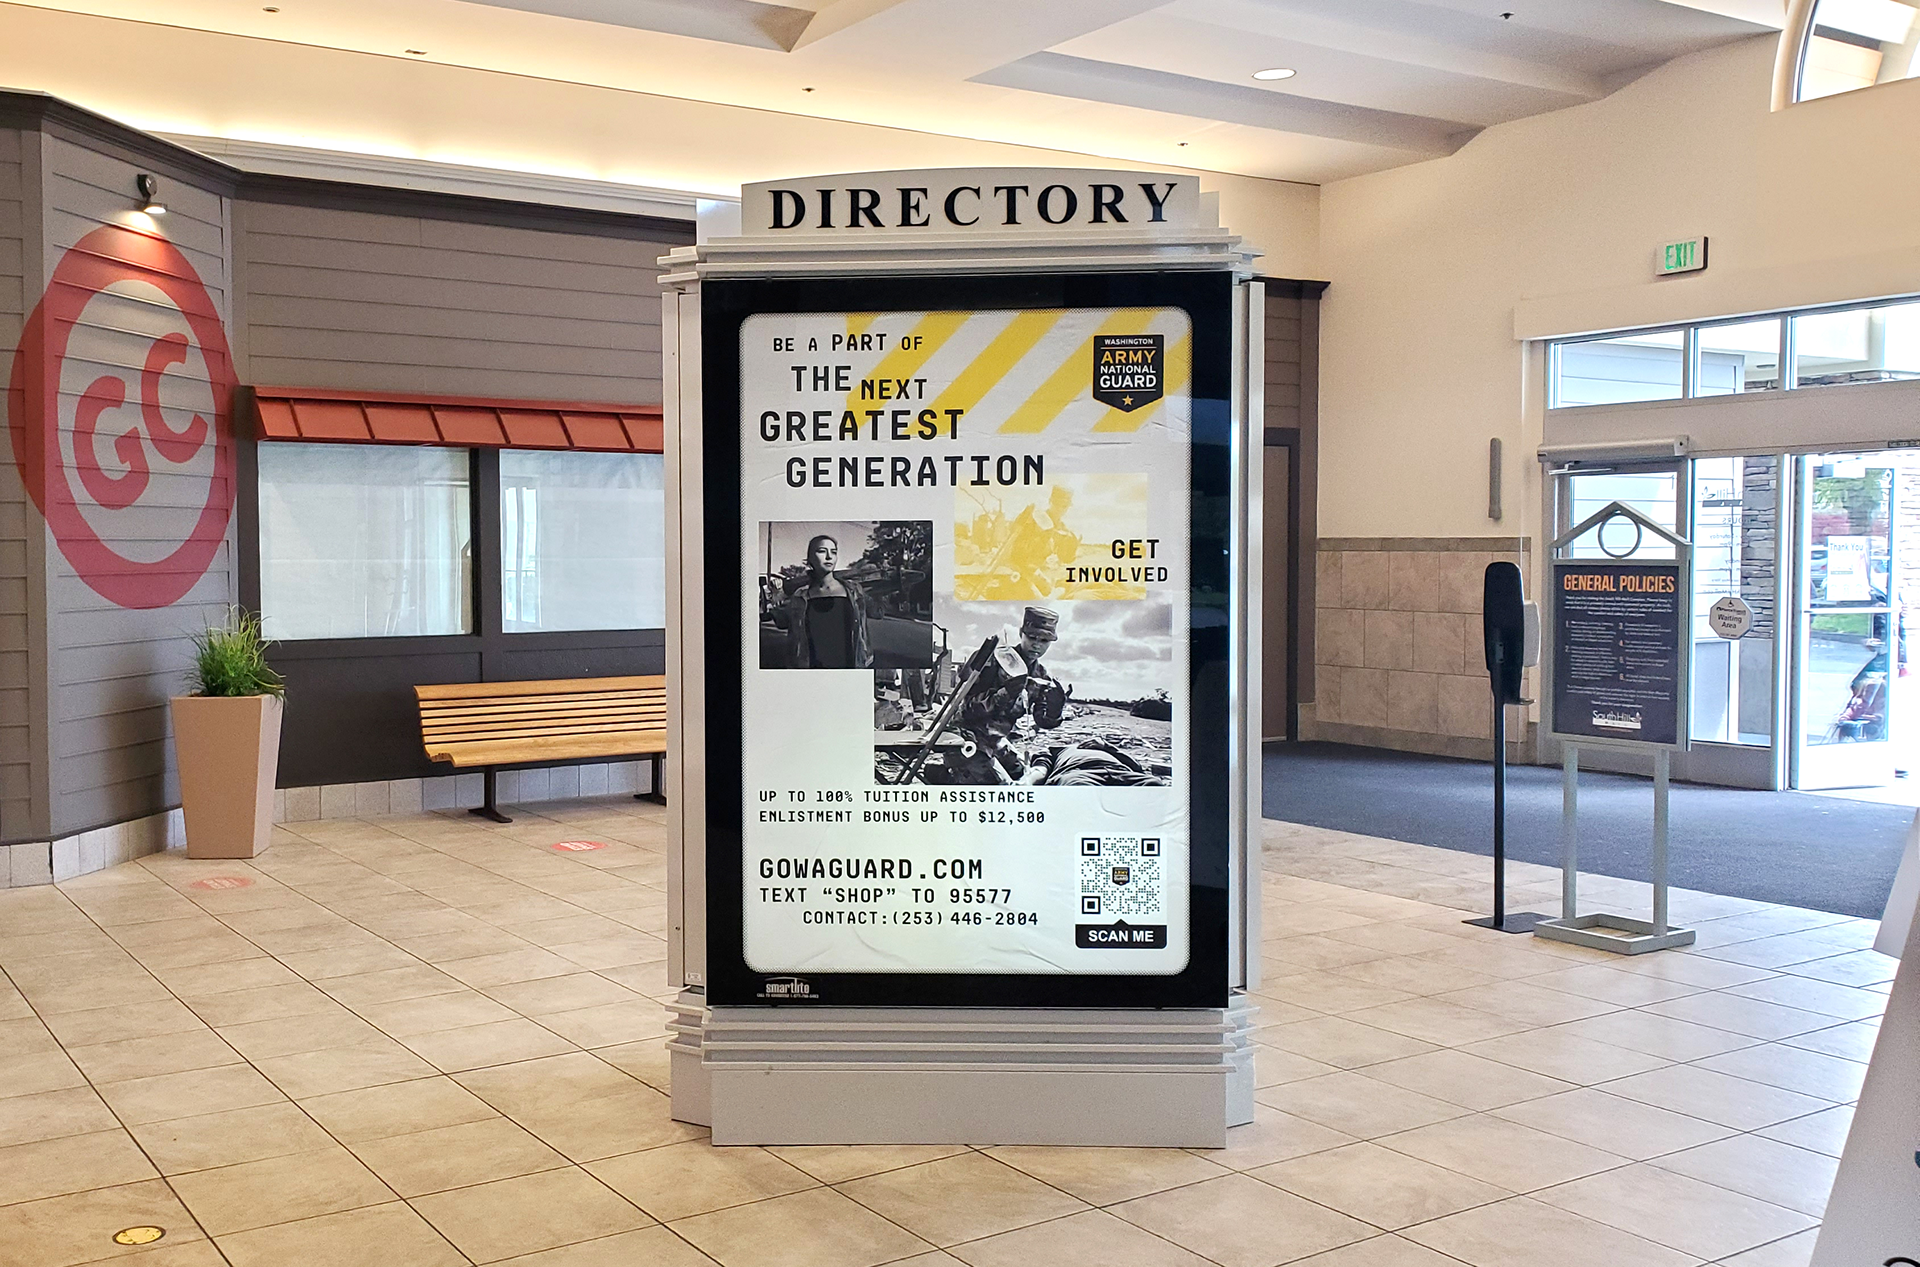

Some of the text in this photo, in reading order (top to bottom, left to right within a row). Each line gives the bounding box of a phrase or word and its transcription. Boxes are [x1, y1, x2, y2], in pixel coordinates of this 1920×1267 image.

[767, 182, 1178, 230] DIRECTORY
[1665, 241, 1696, 270] EXIT
[772, 333, 924, 353] BE A PART OF
[1101, 350, 1156, 364] ARMY
[1100, 365, 1156, 374] NATIONAL
[791, 365, 928, 401] THE NEXT
[1100, 375, 1157, 388] GUARD
[760, 408, 965, 443] GREATEST
[786, 454, 1045, 489] GENERATION
[1111, 538, 1159, 560] GET
[1830, 543, 1864, 551] Thank You
[1065, 567, 1169, 584] INVOLVED
[1564, 574, 1675, 593] GENERAL POLICIES
[1717, 613, 1742, 624] Waiting
[1721, 621, 1737, 629] Area
[759, 790, 1035, 804] UP TO 100% TUITION ASSISTANCE
[759, 810, 1045, 825] ENLISTMENT BONUS UP TO $12,500
[759, 858, 983, 880] GOWAGUARD.COM
[759, 887, 808, 903] TEXT
[911, 888, 936, 904] TO
[949, 888, 1012, 904] 95577
[950, 910, 1039, 926] 446-2804
[1088, 930, 1154, 942] SCAN ME
